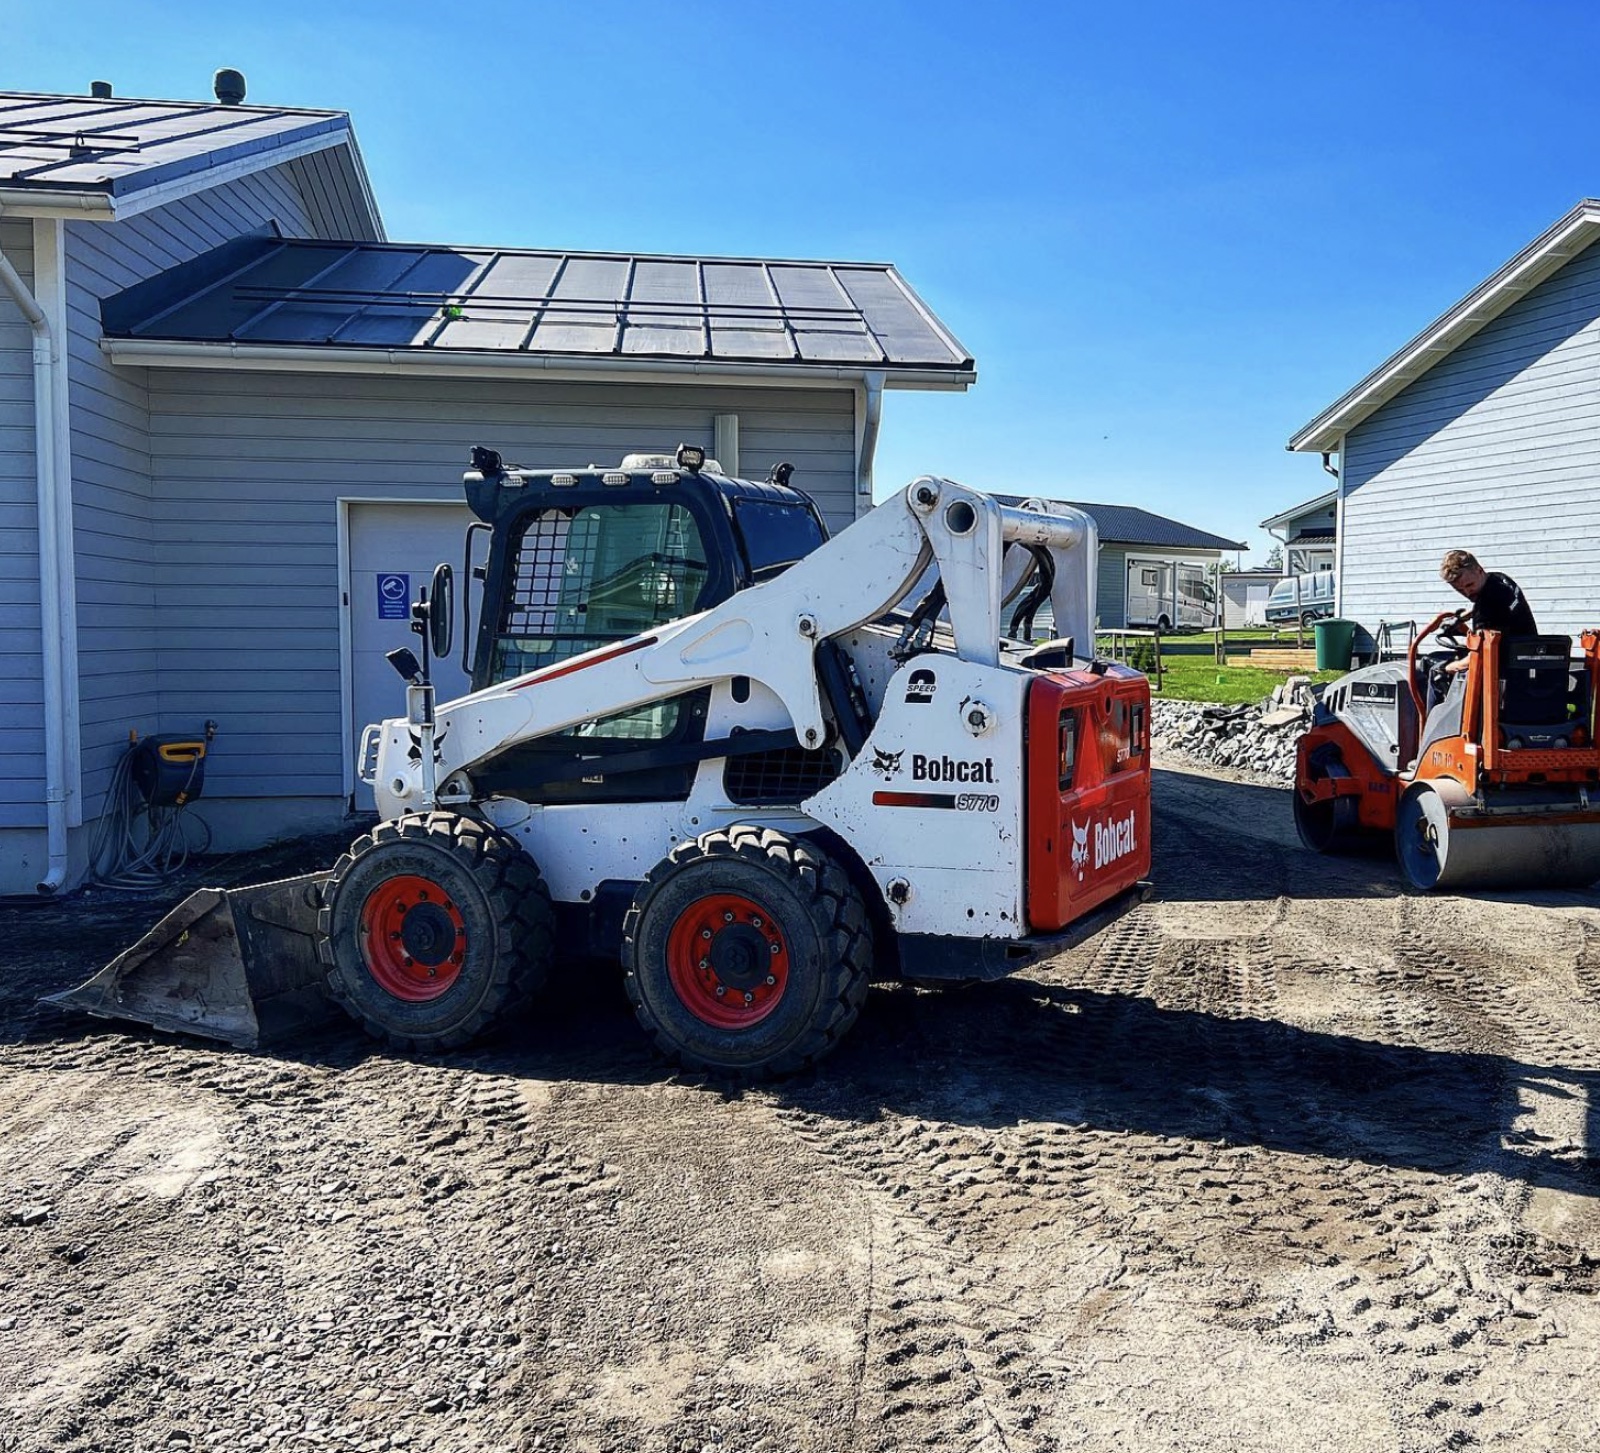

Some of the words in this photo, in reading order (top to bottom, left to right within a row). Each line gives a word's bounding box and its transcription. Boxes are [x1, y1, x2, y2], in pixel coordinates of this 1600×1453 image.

[904, 669, 936, 704] 2
[907, 684, 937, 692] SPEED
[912, 754, 994, 784] Bobcat
[957, 793, 1000, 812] S770
[1095, 809, 1135, 870] Bobcat
